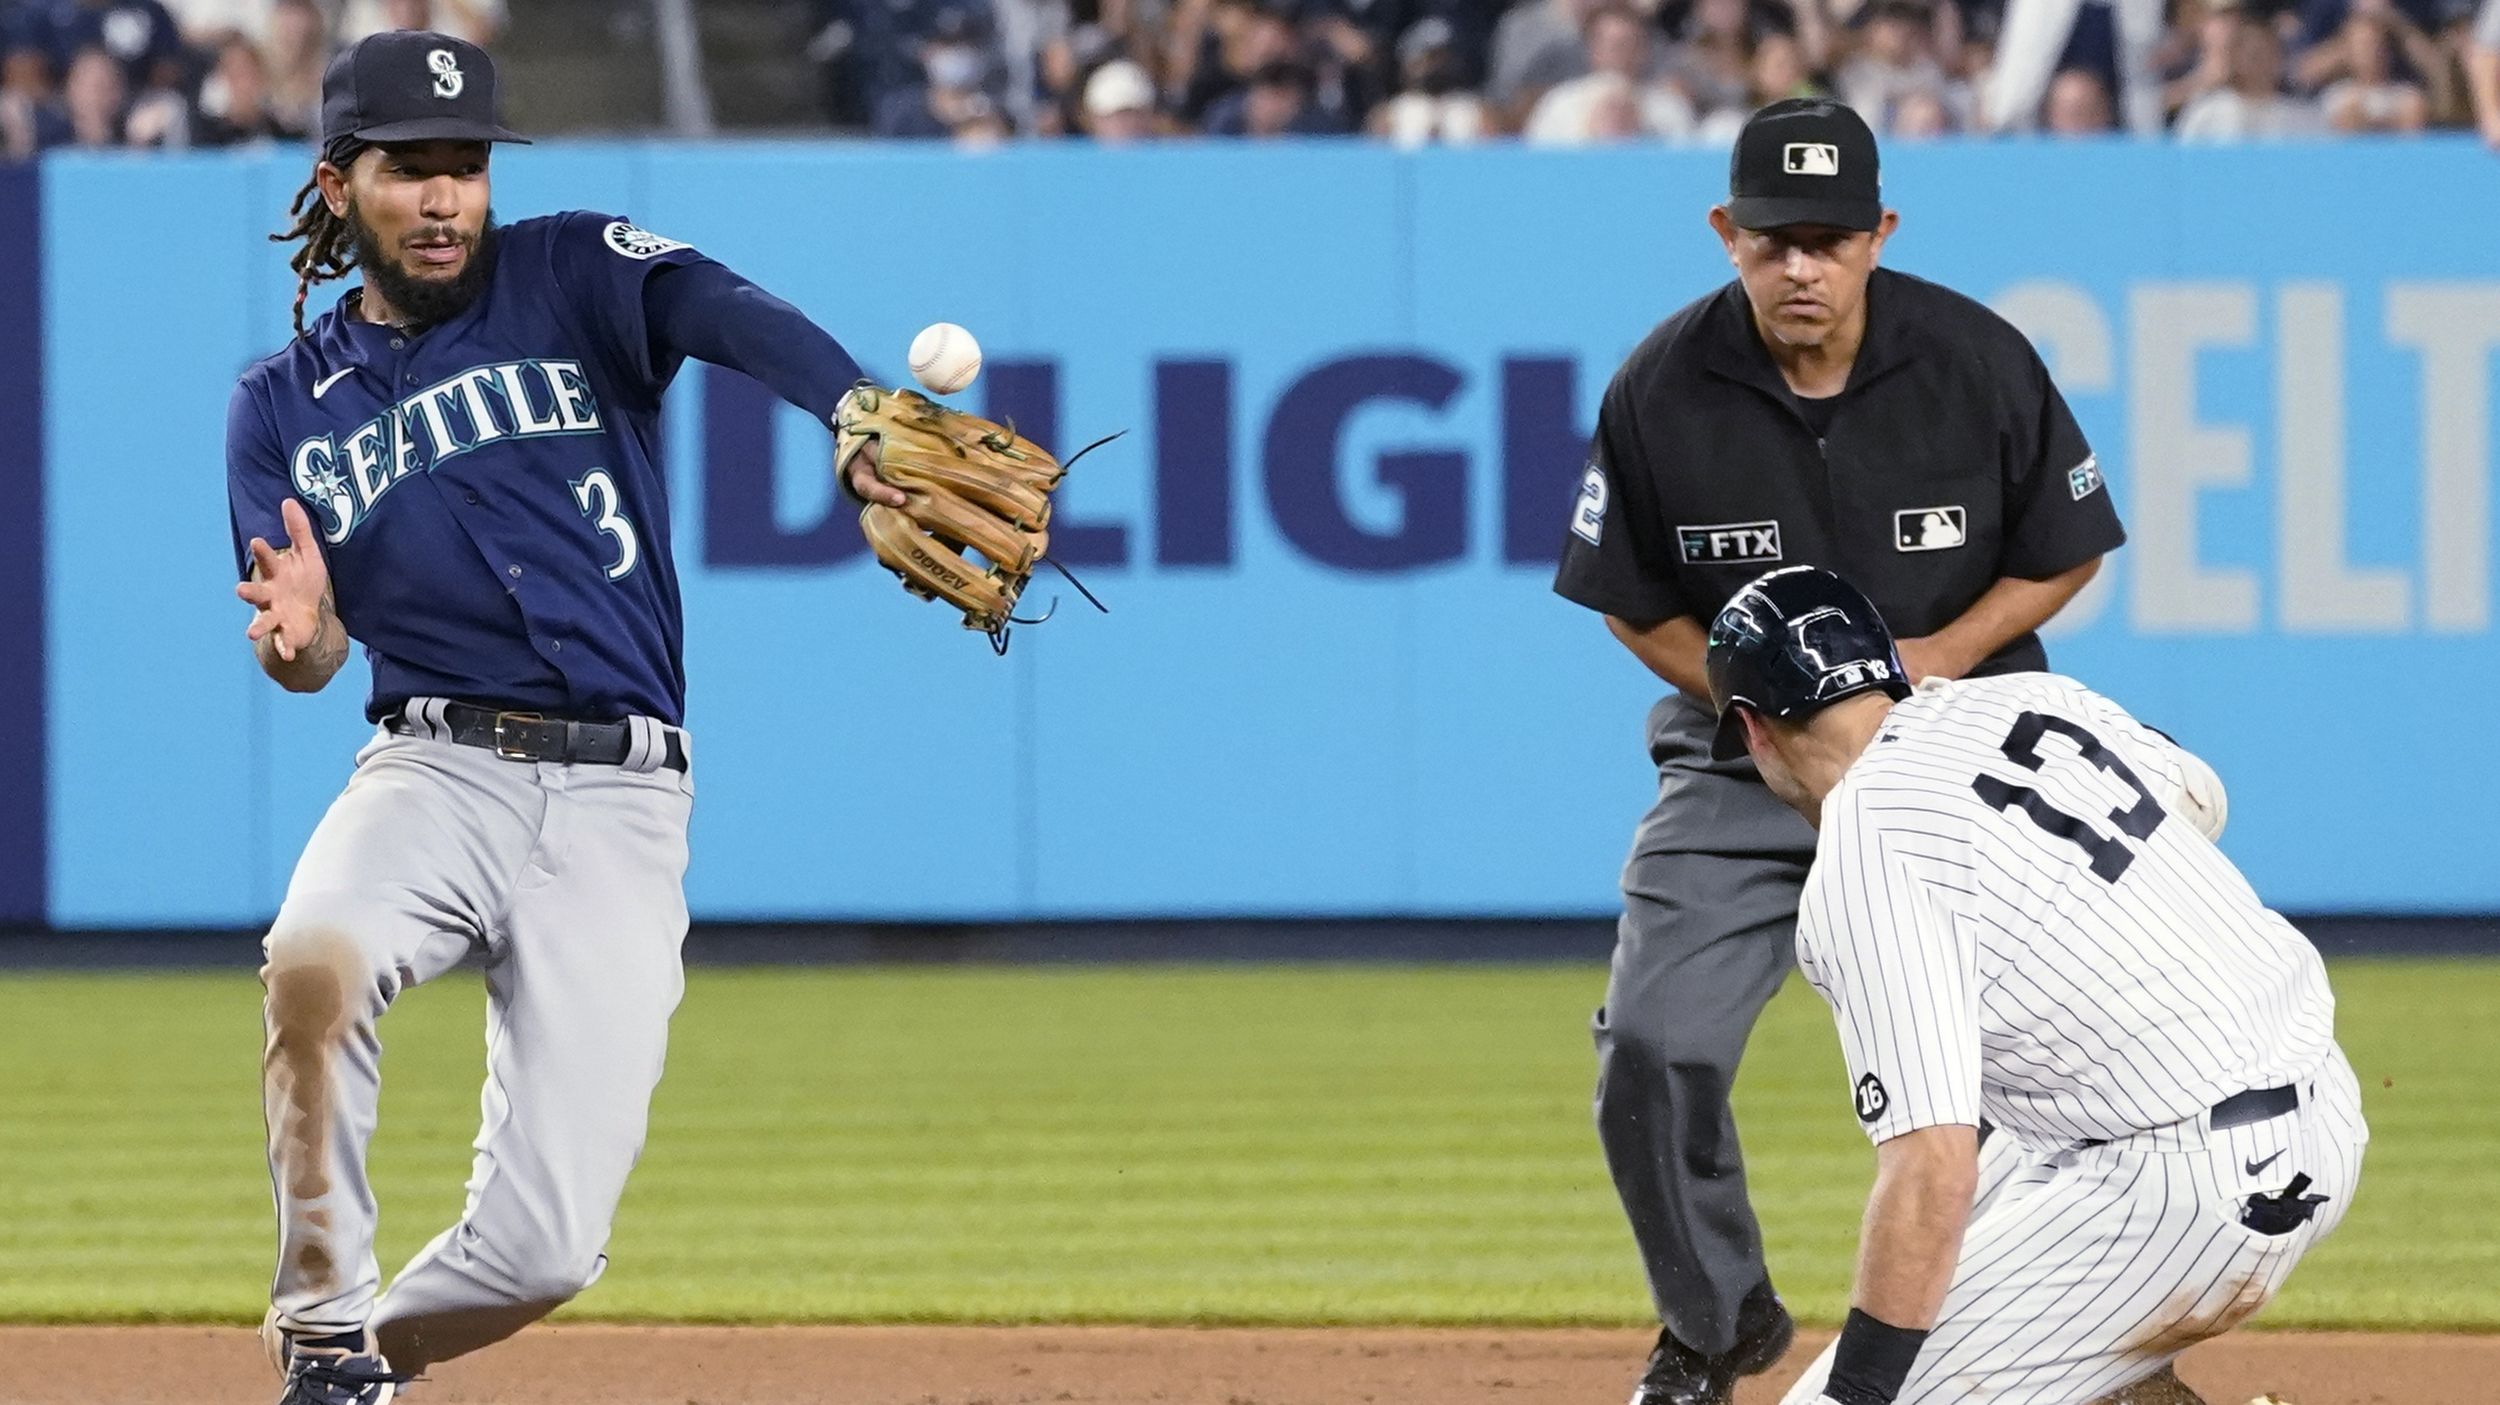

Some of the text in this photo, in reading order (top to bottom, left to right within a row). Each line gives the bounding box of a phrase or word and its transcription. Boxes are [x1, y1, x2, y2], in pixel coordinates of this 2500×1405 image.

[291, 359, 605, 546] SEATTLE
[569, 467, 639, 582] 3
[1710, 528, 1778, 558] FTX
[911, 548, 970, 590] A2000
[1869, 659, 1890, 680] 13
[1971, 710, 2167, 884] 13
[1859, 1079, 1884, 1115] 16
